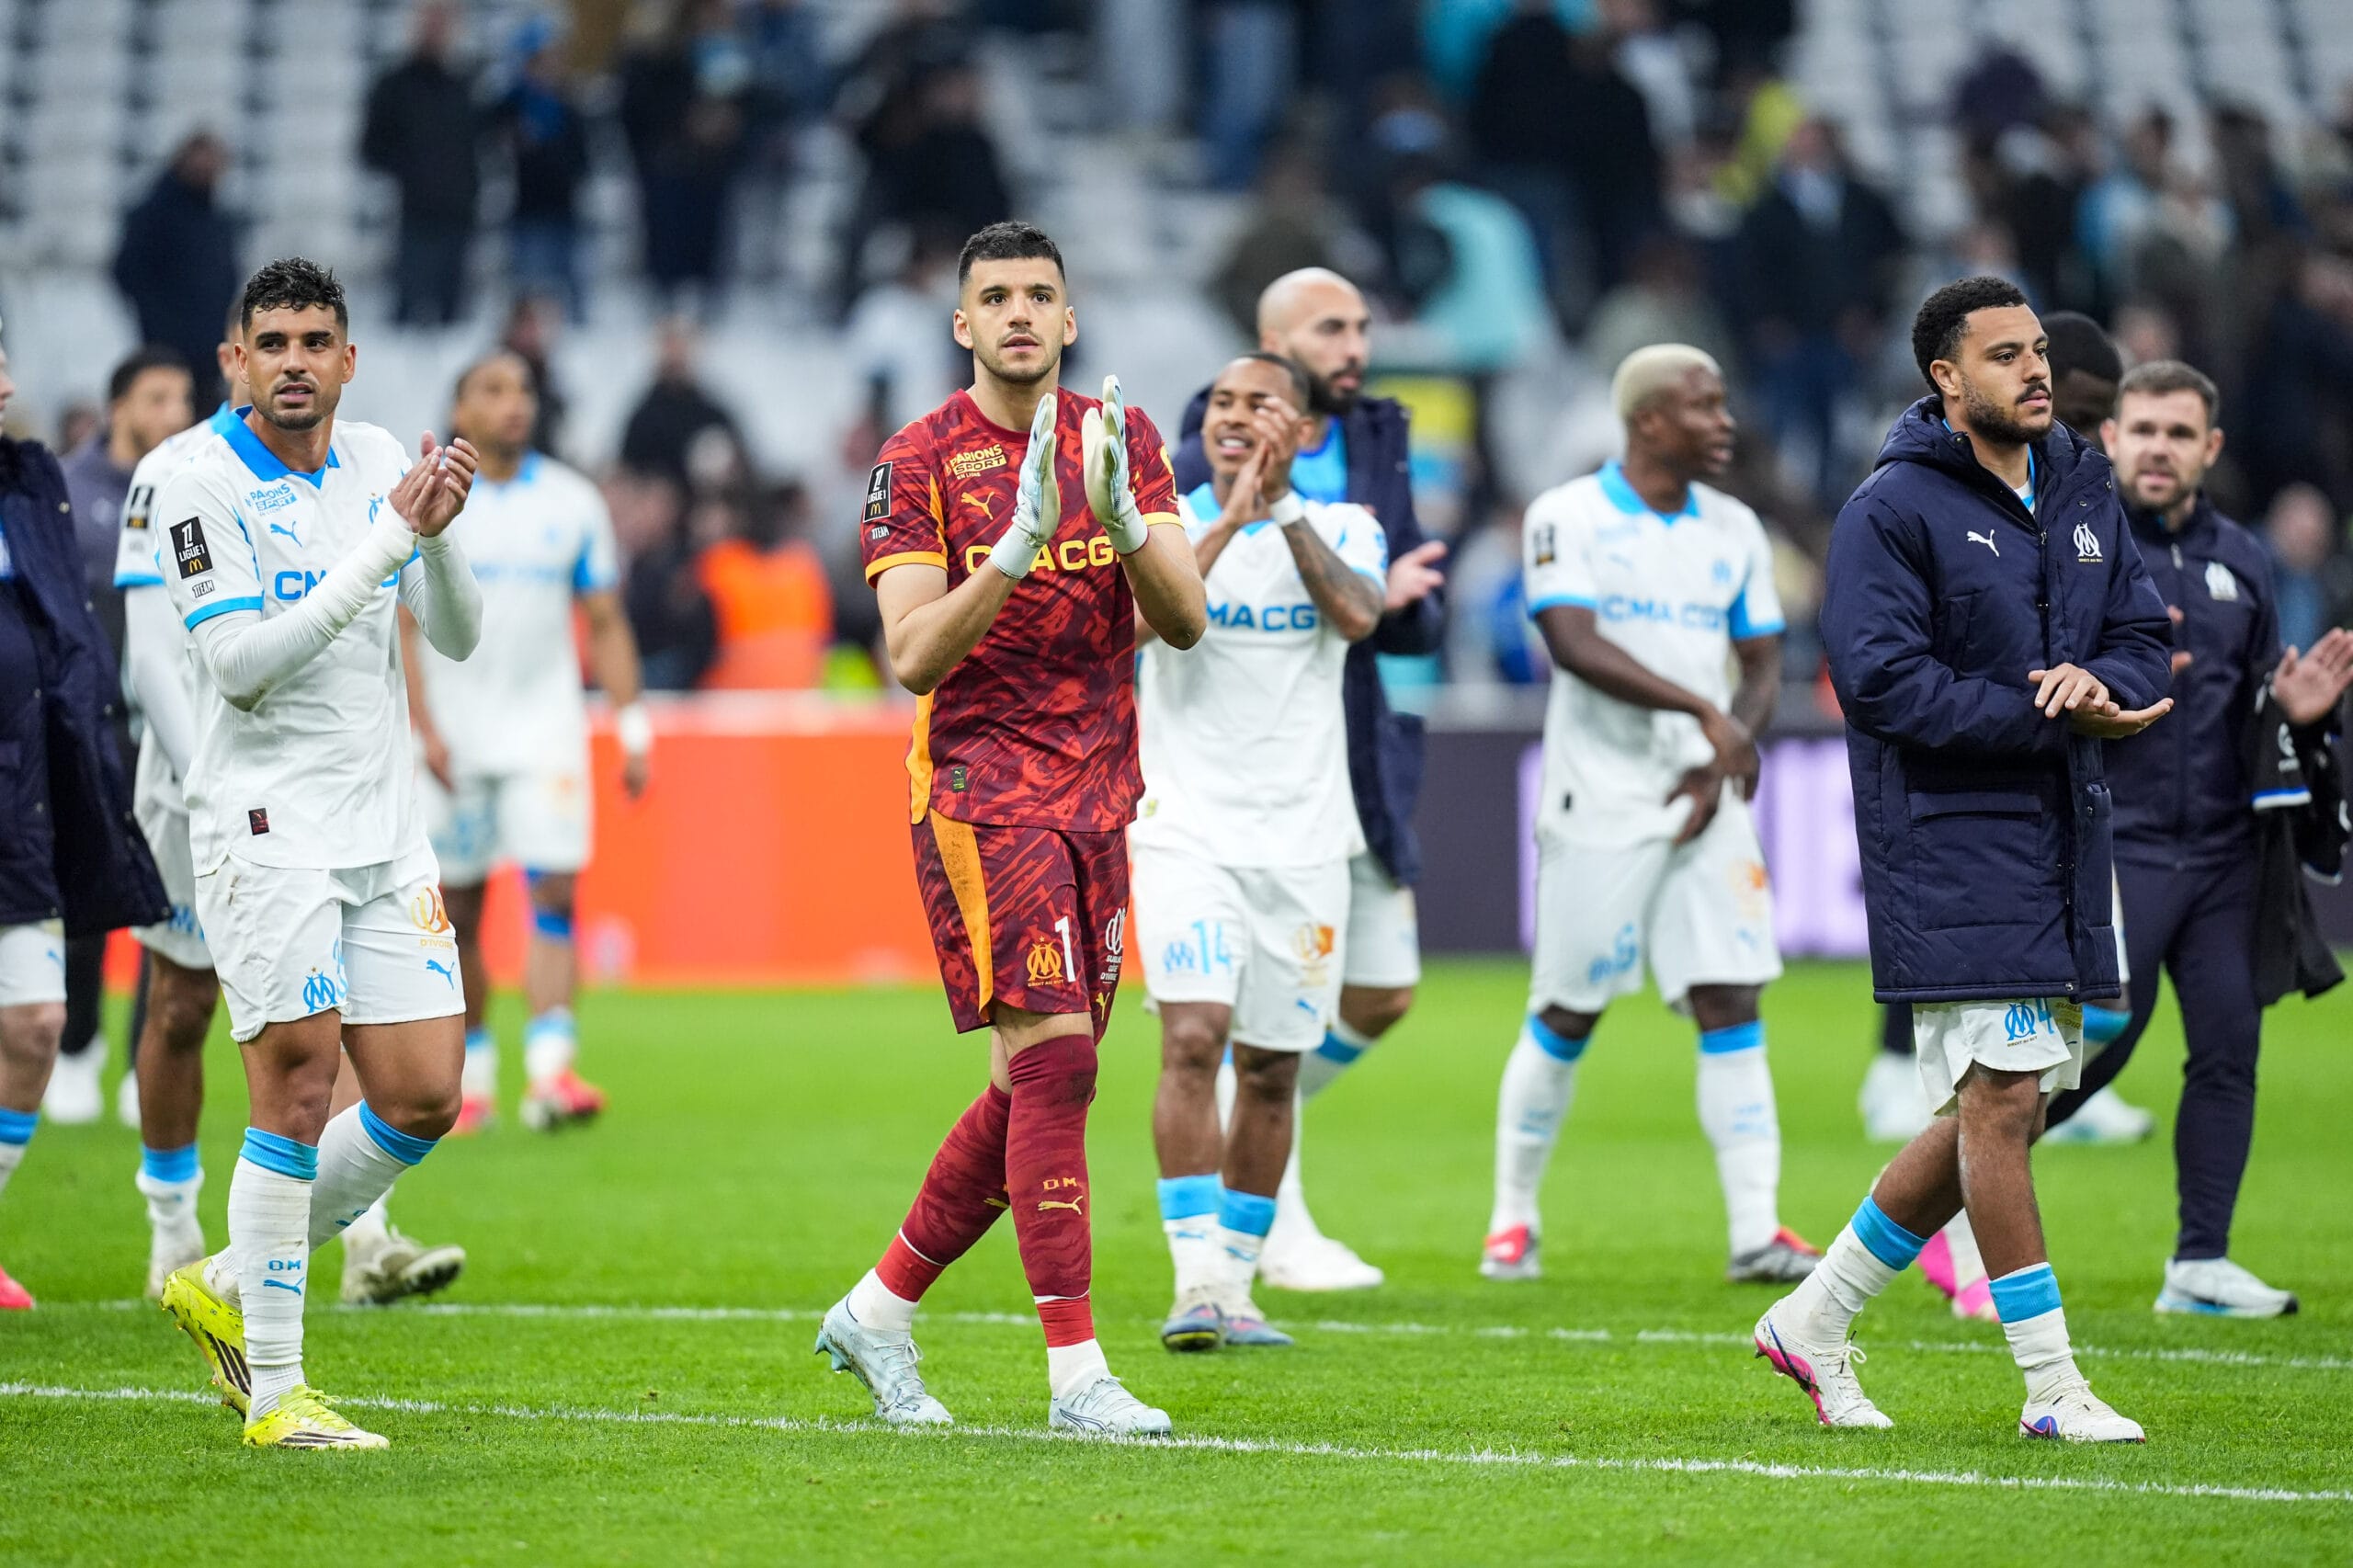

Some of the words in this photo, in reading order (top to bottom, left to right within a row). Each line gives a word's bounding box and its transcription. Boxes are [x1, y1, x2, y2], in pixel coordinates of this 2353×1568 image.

[949, 444, 1003, 467] PARIONS
[956, 456, 1003, 473] SPORT
[250, 483, 290, 500] PAONS
[178, 545, 201, 562] LIGUE
[1059, 535, 1120, 571] CG
[1206, 602, 1256, 628] MA
[1263, 603, 1317, 632] CG
[1054, 915, 1076, 983] 1
[1191, 920, 1233, 976] 14
[1042, 1177, 1078, 1190] OM
[268, 1260, 301, 1271] OM
